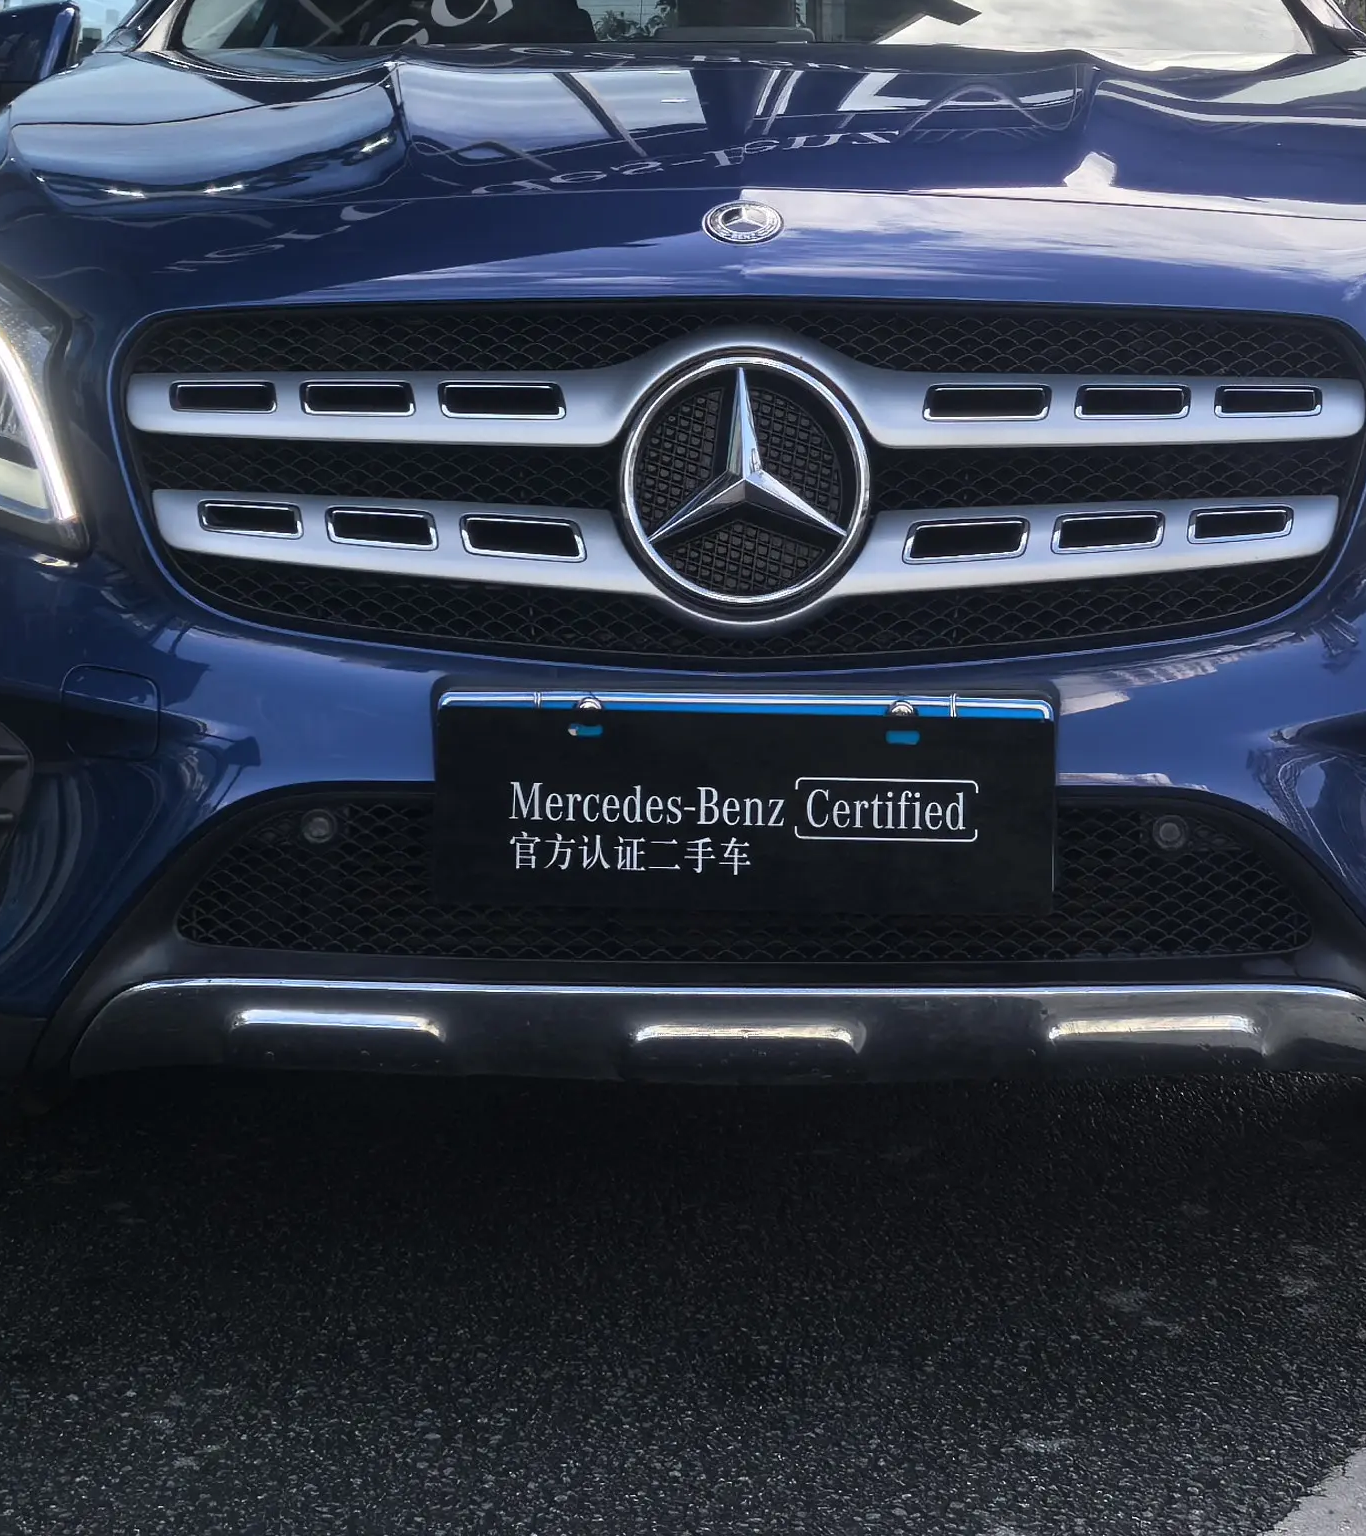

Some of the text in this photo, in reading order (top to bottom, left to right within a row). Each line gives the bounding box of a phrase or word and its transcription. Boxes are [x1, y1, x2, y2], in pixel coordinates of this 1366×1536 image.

[508, 781, 966, 831] Mercedes-Benz Certified
[509, 832, 751, 875] 官方认证二手车
